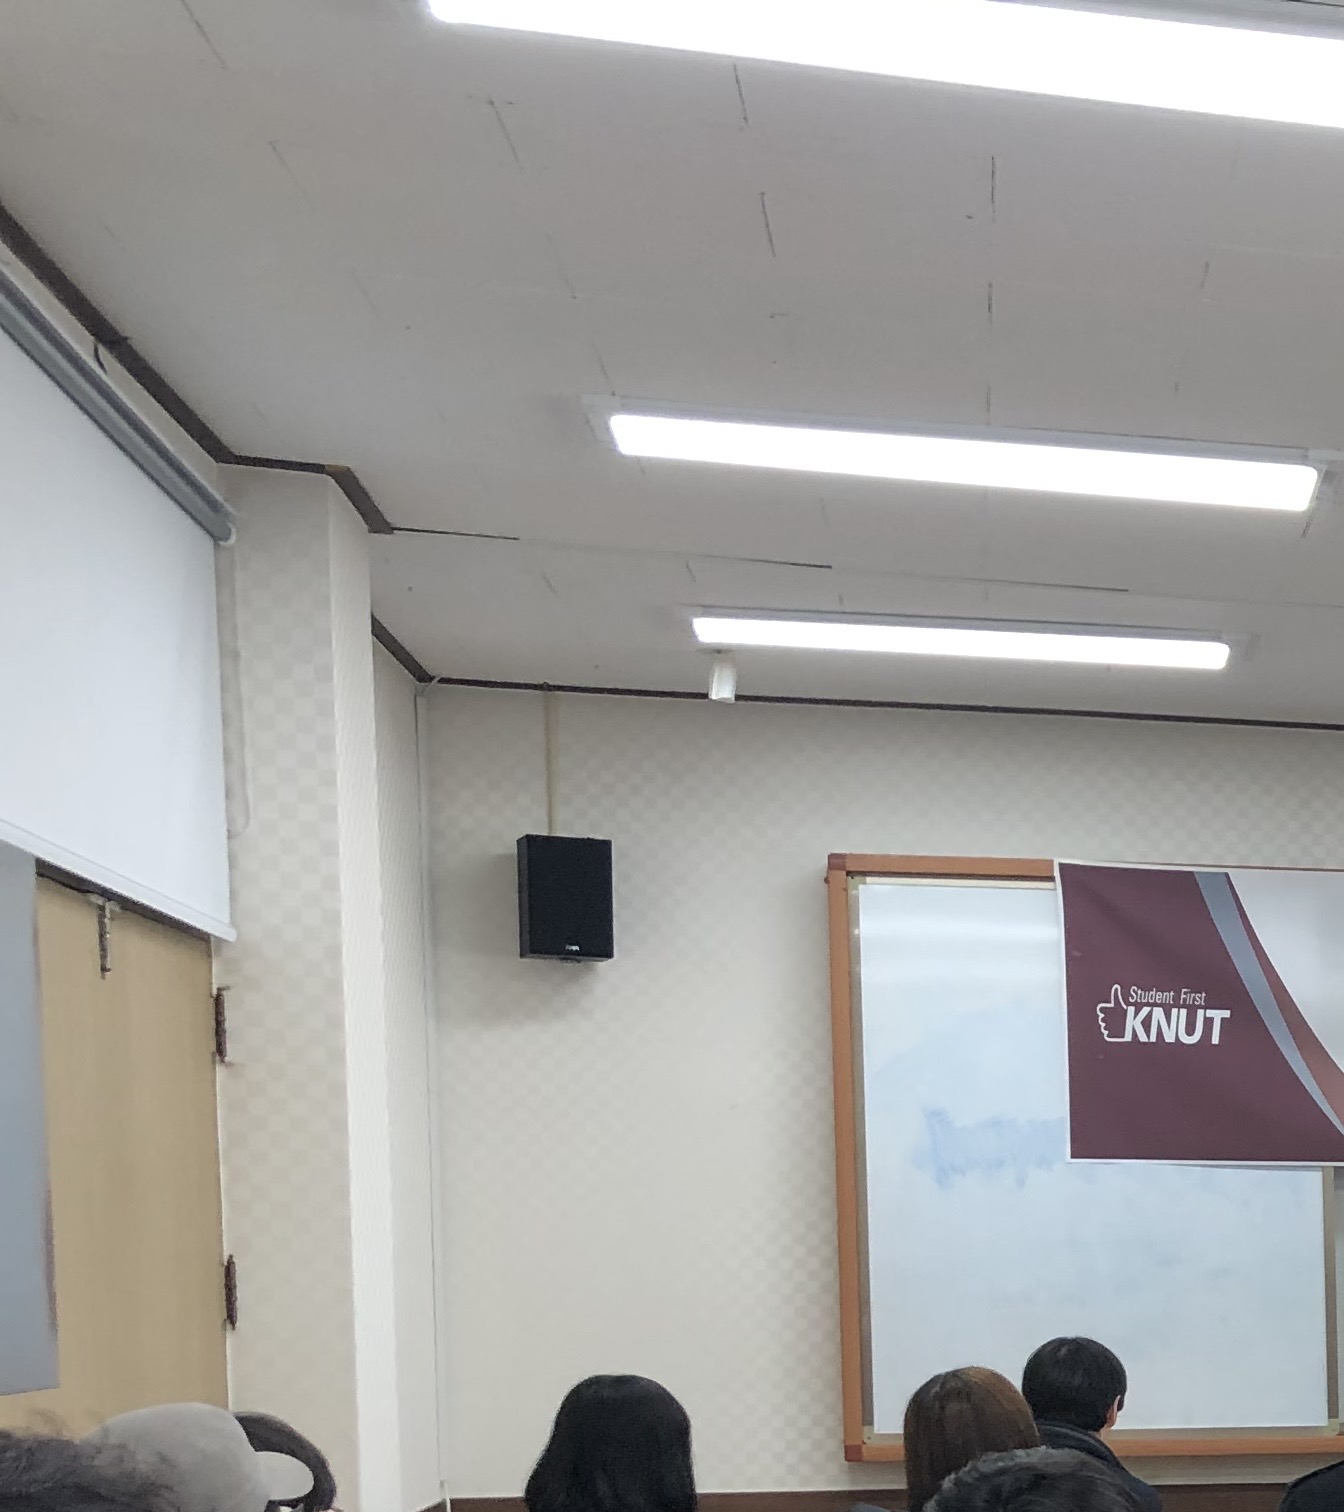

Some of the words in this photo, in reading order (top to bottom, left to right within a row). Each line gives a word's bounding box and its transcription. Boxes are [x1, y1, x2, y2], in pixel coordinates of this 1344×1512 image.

[1129, 985, 1174, 1004] Student
[1180, 988, 1206, 1005] First
[1123, 1005, 1231, 1045] KNUT
